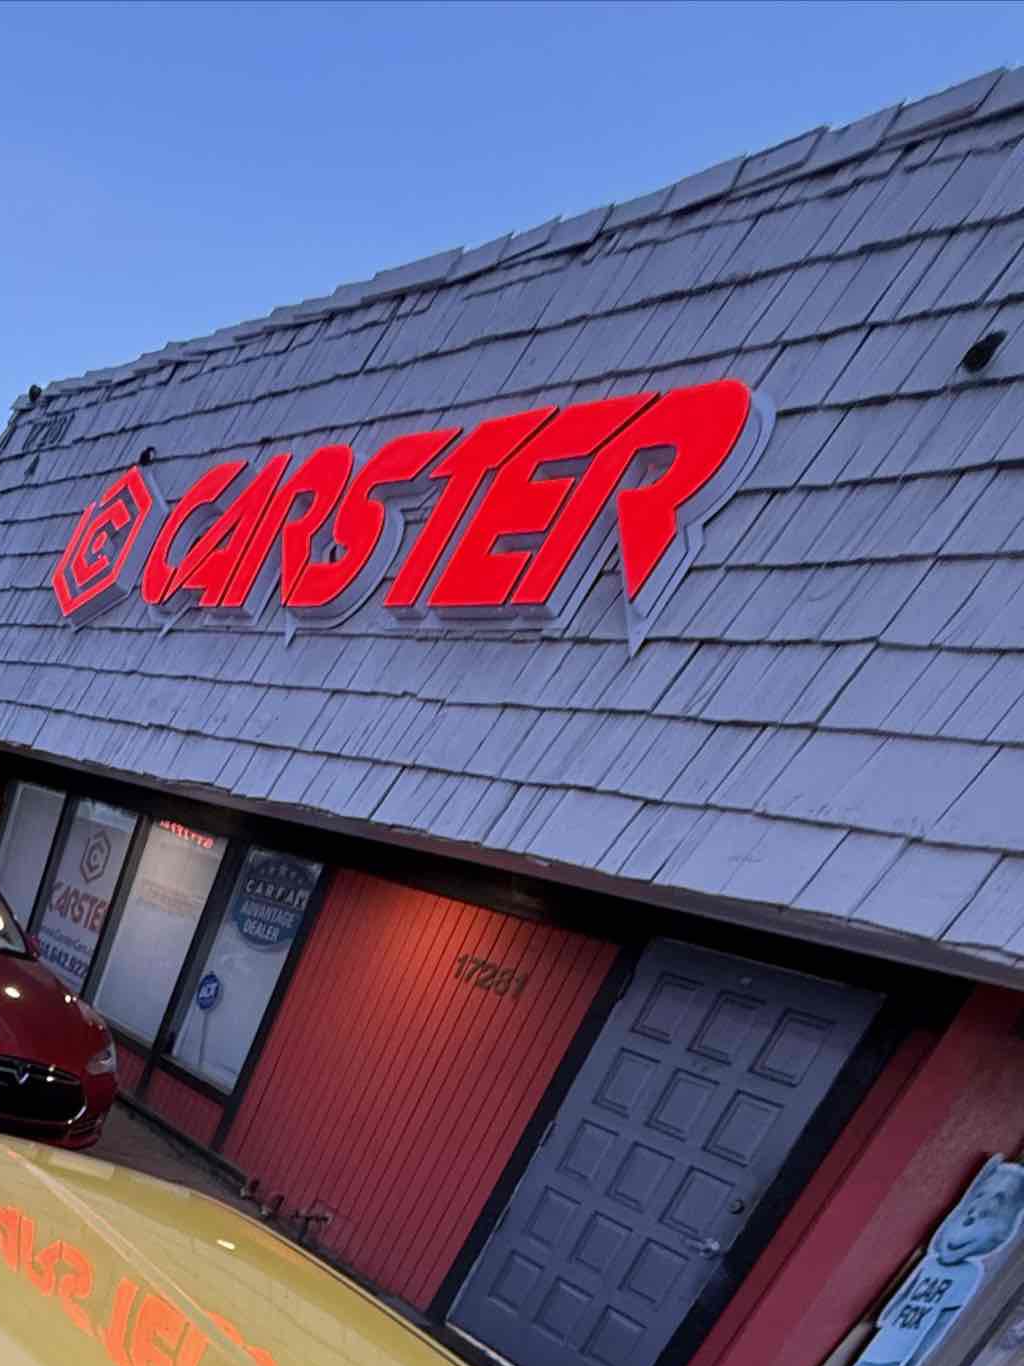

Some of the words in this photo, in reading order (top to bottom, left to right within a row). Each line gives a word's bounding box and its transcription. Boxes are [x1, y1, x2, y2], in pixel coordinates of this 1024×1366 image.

[142, 379, 750, 608] CARSTER
[911, 1277, 953, 1303] CAR
[895, 1303, 933, 1330] FOX
